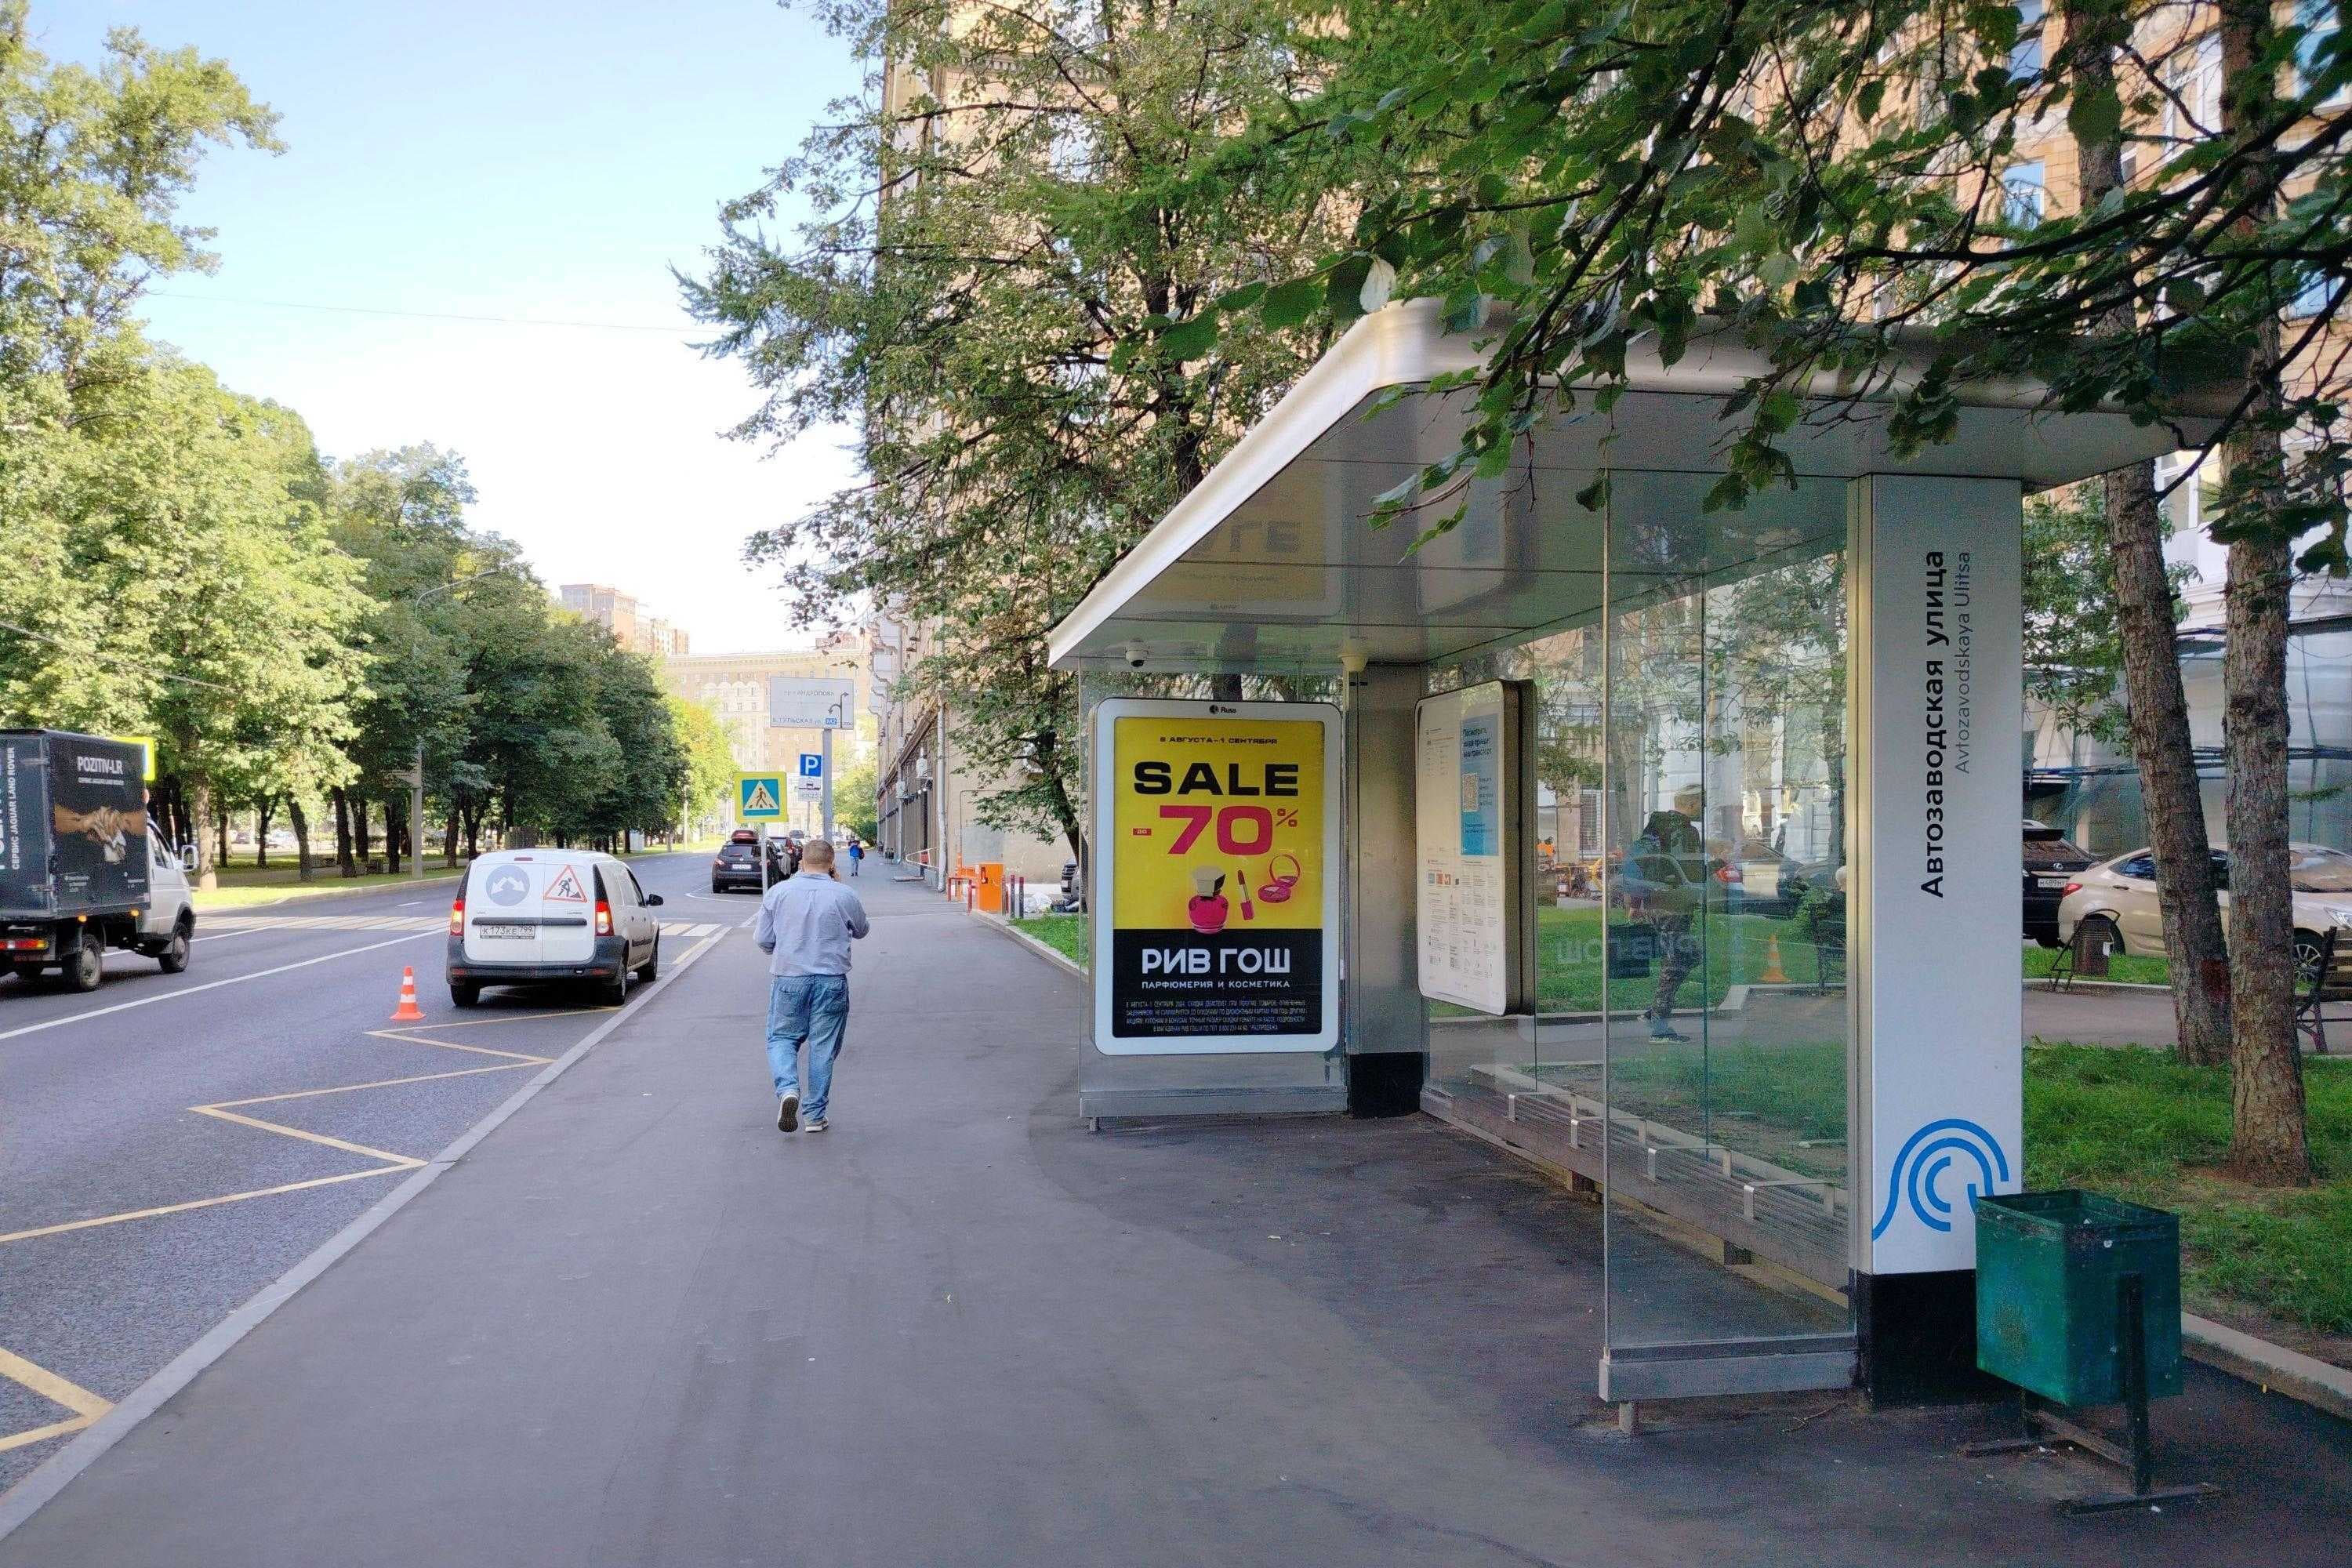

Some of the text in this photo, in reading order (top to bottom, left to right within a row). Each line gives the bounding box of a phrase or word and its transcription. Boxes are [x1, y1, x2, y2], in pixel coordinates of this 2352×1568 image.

[1954, 552, 1973, 775] Avtozavodskaya Ulitsa
[1921, 551, 1949, 898] Автозаводская улица
[77, 756, 124, 775] POZITIV-LR
[805, 756, 818, 775] P
[1134, 761, 1299, 797] SALE
[6, 747, 20, 869] СЕРВИС JAGUAR LAND ROVER
[1142, 947, 1290, 975] РИВ ГОШ
[1142, 981, 1214, 989] ПАРФЮМЕРИЯ
[1229, 980, 1290, 989] КОСМЕТИКА
